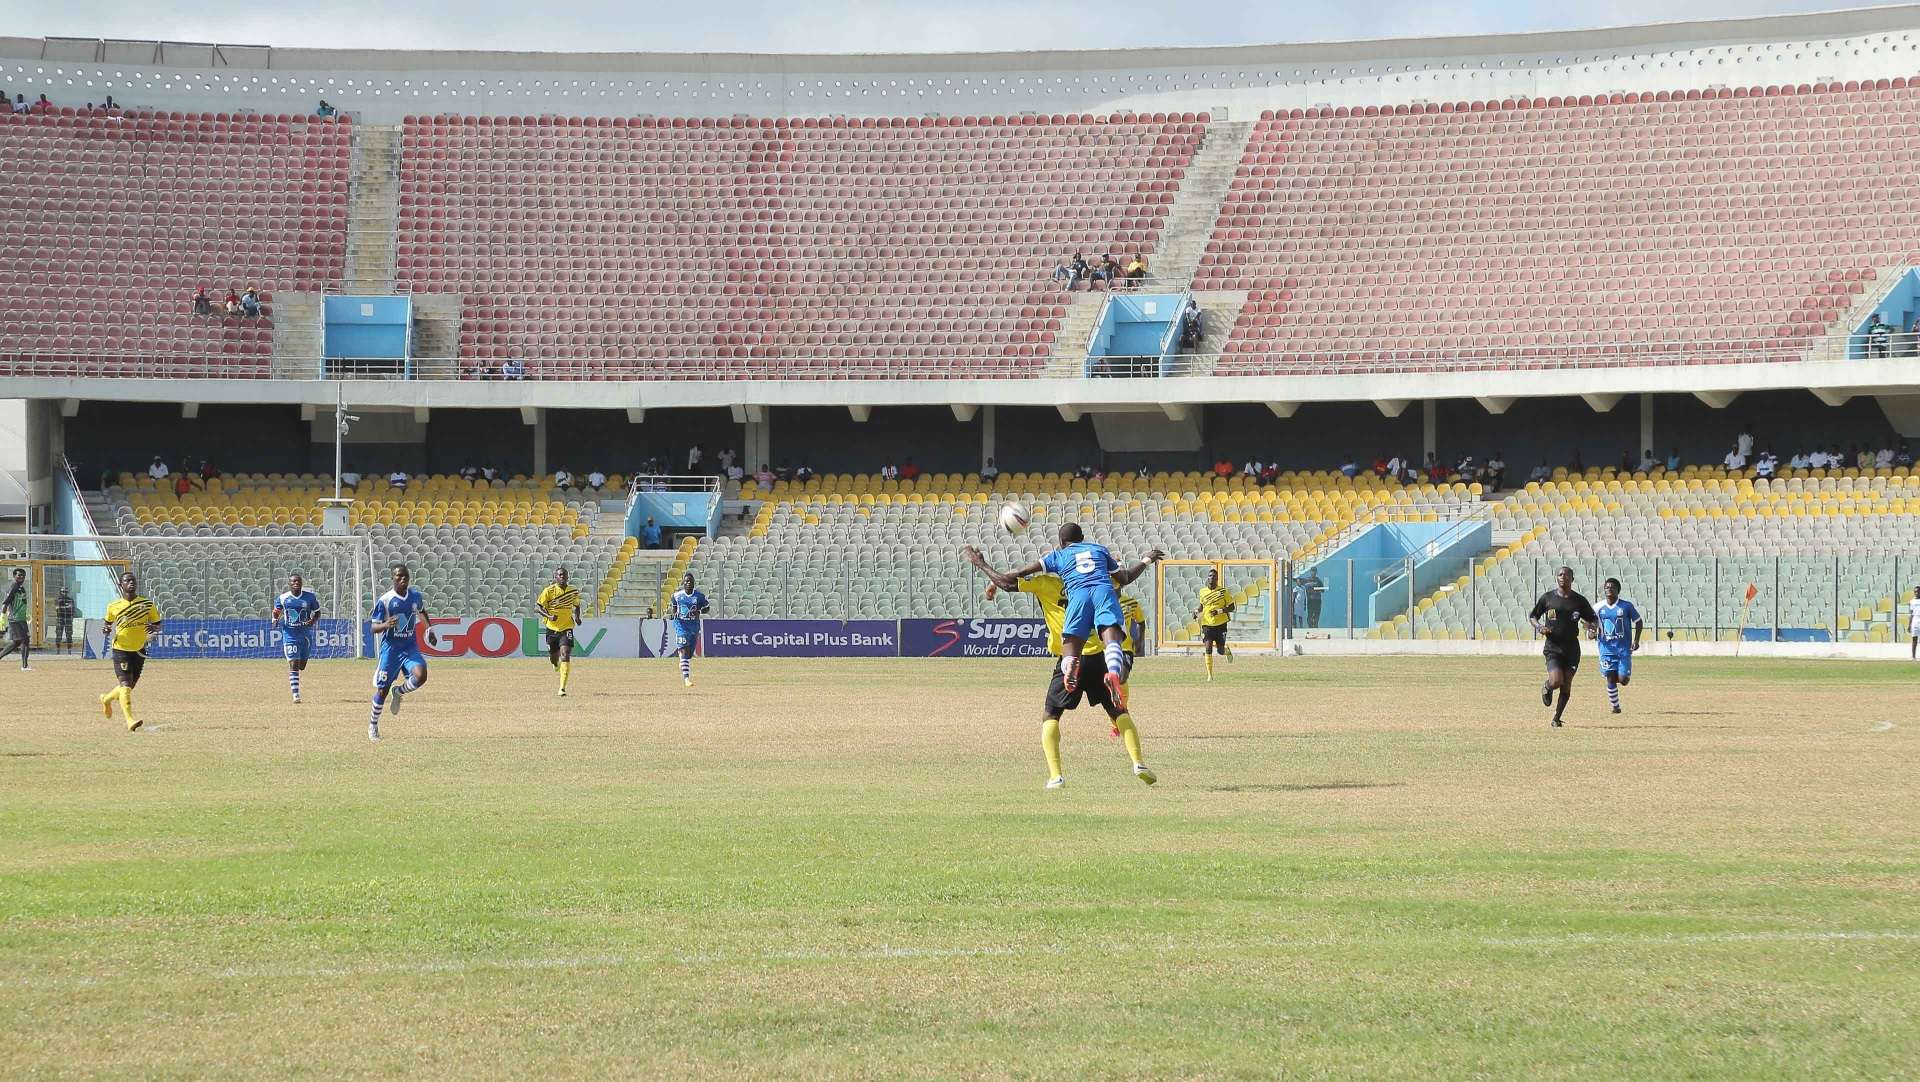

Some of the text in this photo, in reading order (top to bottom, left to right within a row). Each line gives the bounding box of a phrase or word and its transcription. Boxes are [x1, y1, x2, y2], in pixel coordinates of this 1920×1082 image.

[1074, 551, 1096, 574] 5
[194, 629, 265, 651] Capital
[316, 629, 366, 648] Ban
[711, 632, 893, 648] First Capital Plus Bank
[968, 618, 1050, 644] Super
[287, 645, 298, 654] 20
[963, 644, 999, 656] World
[1002, 644, 1015, 656] of
